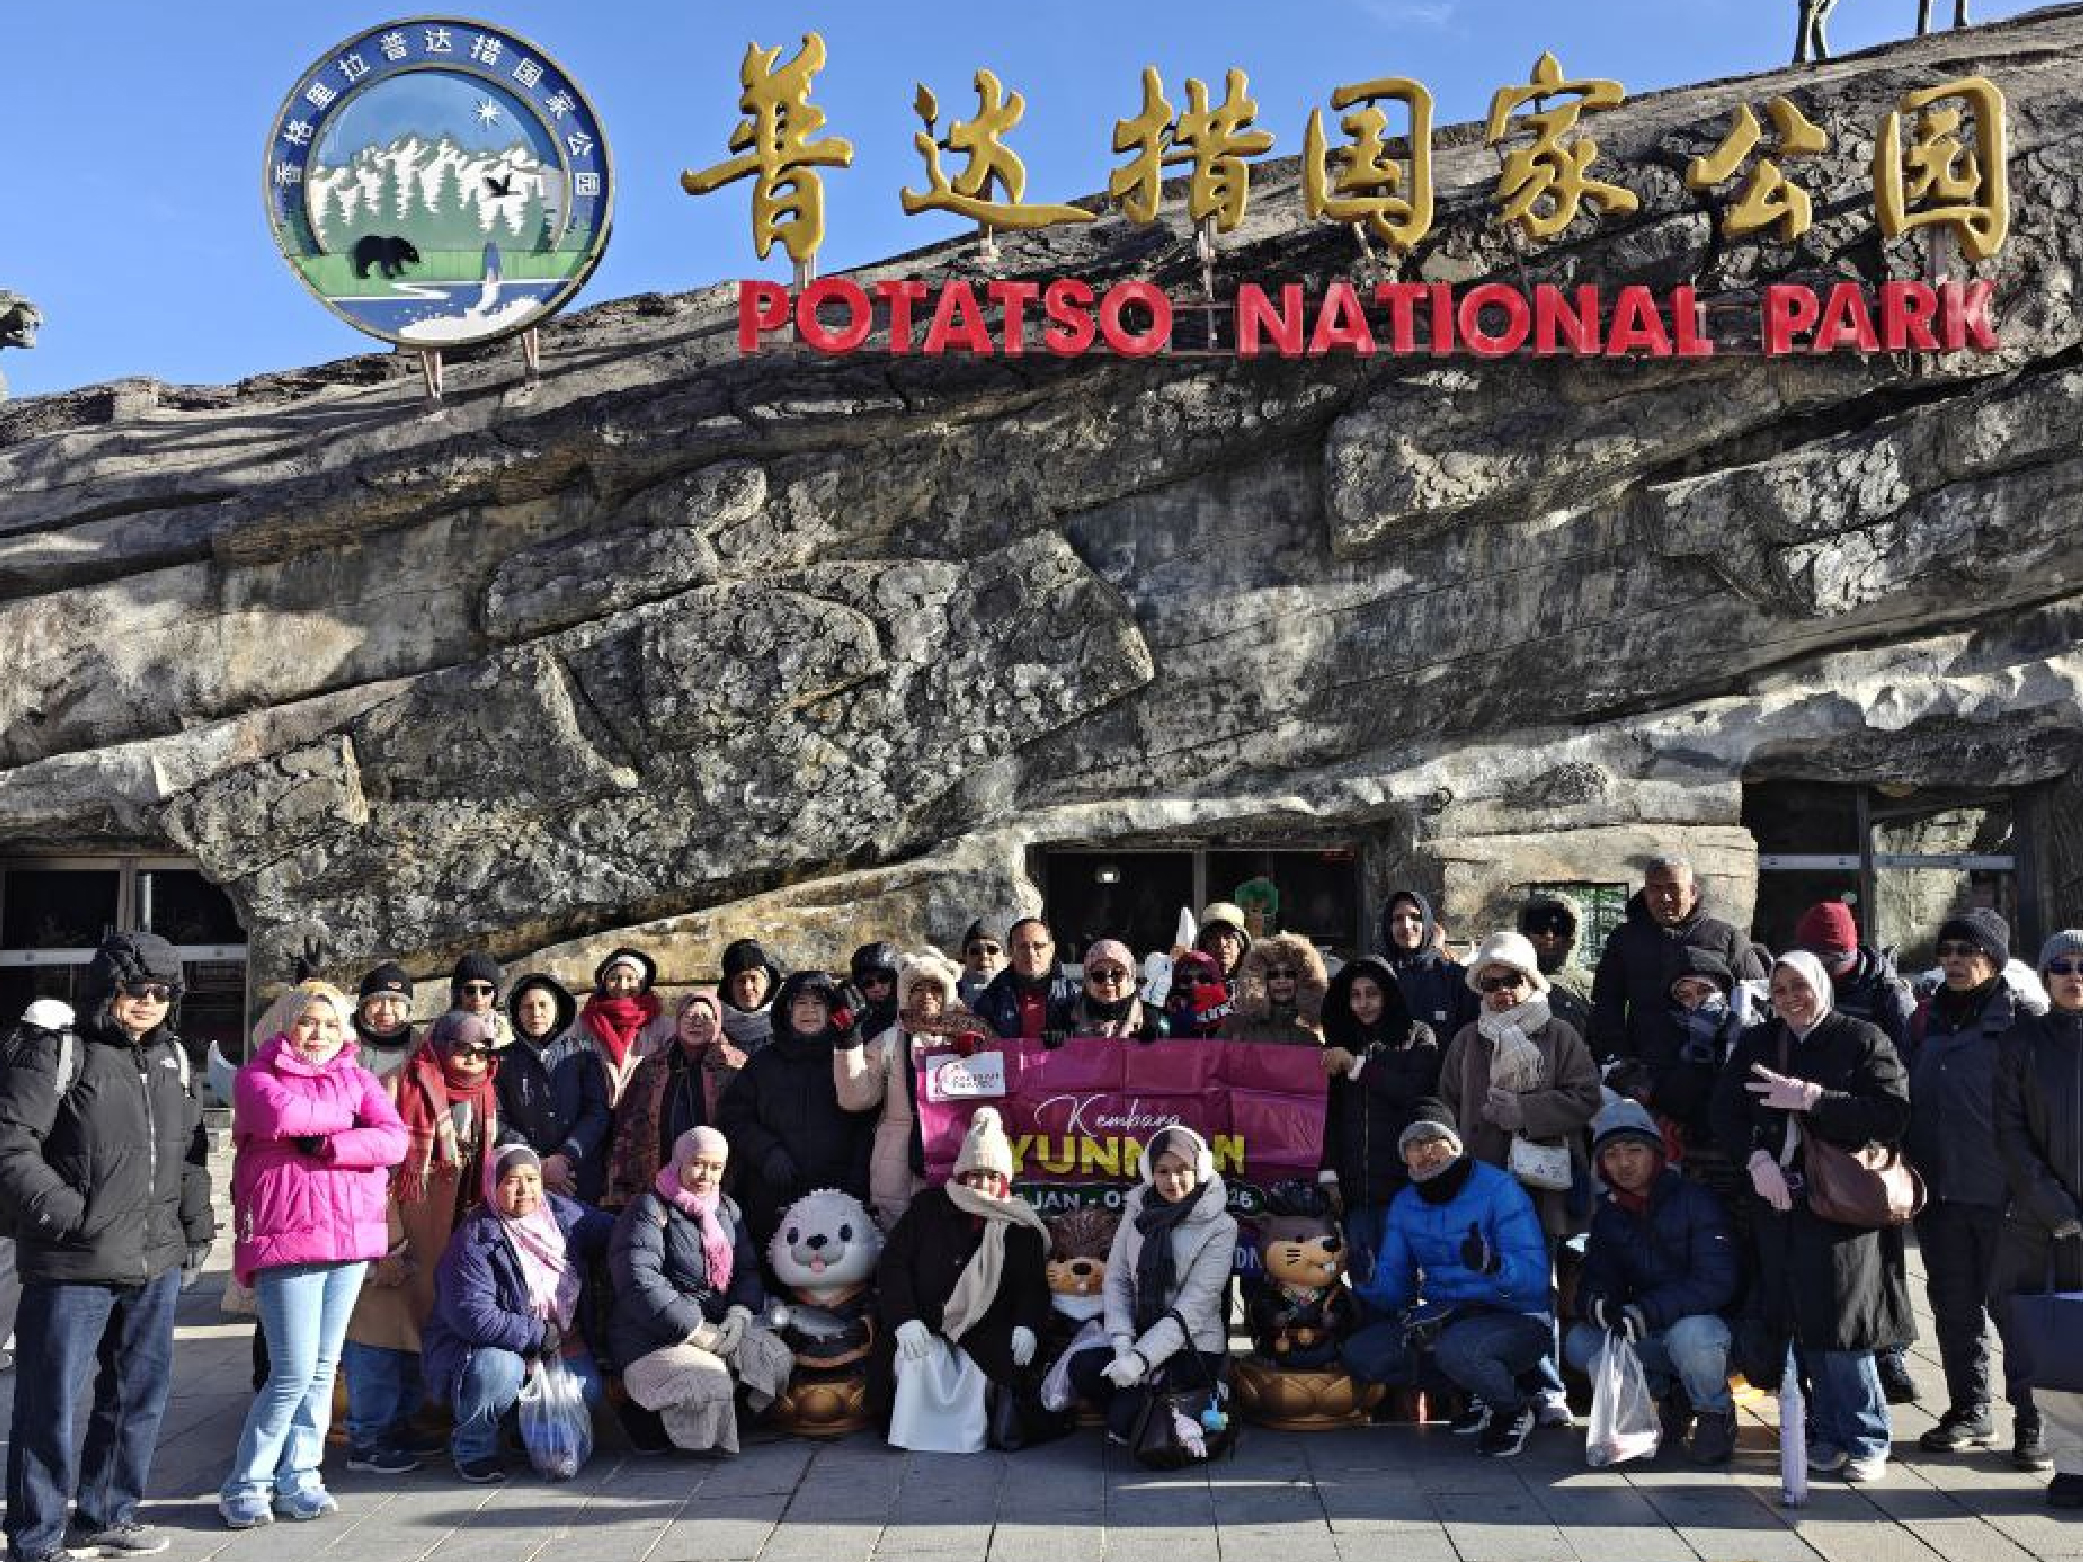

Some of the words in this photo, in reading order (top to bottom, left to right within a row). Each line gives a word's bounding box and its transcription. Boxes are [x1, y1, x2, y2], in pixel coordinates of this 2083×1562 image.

[681, 32, 2008, 262] 普达措国家公园
[737, 277, 1174, 359] POTATSO
[1236, 281, 1715, 359] NATIONAL
[1762, 280, 2000, 358] PARK
[1033, 1093, 1181, 1138] Kembara
[1011, 1133, 1246, 1178] YUNNN
[1031, 1189, 1081, 1210] JAN
